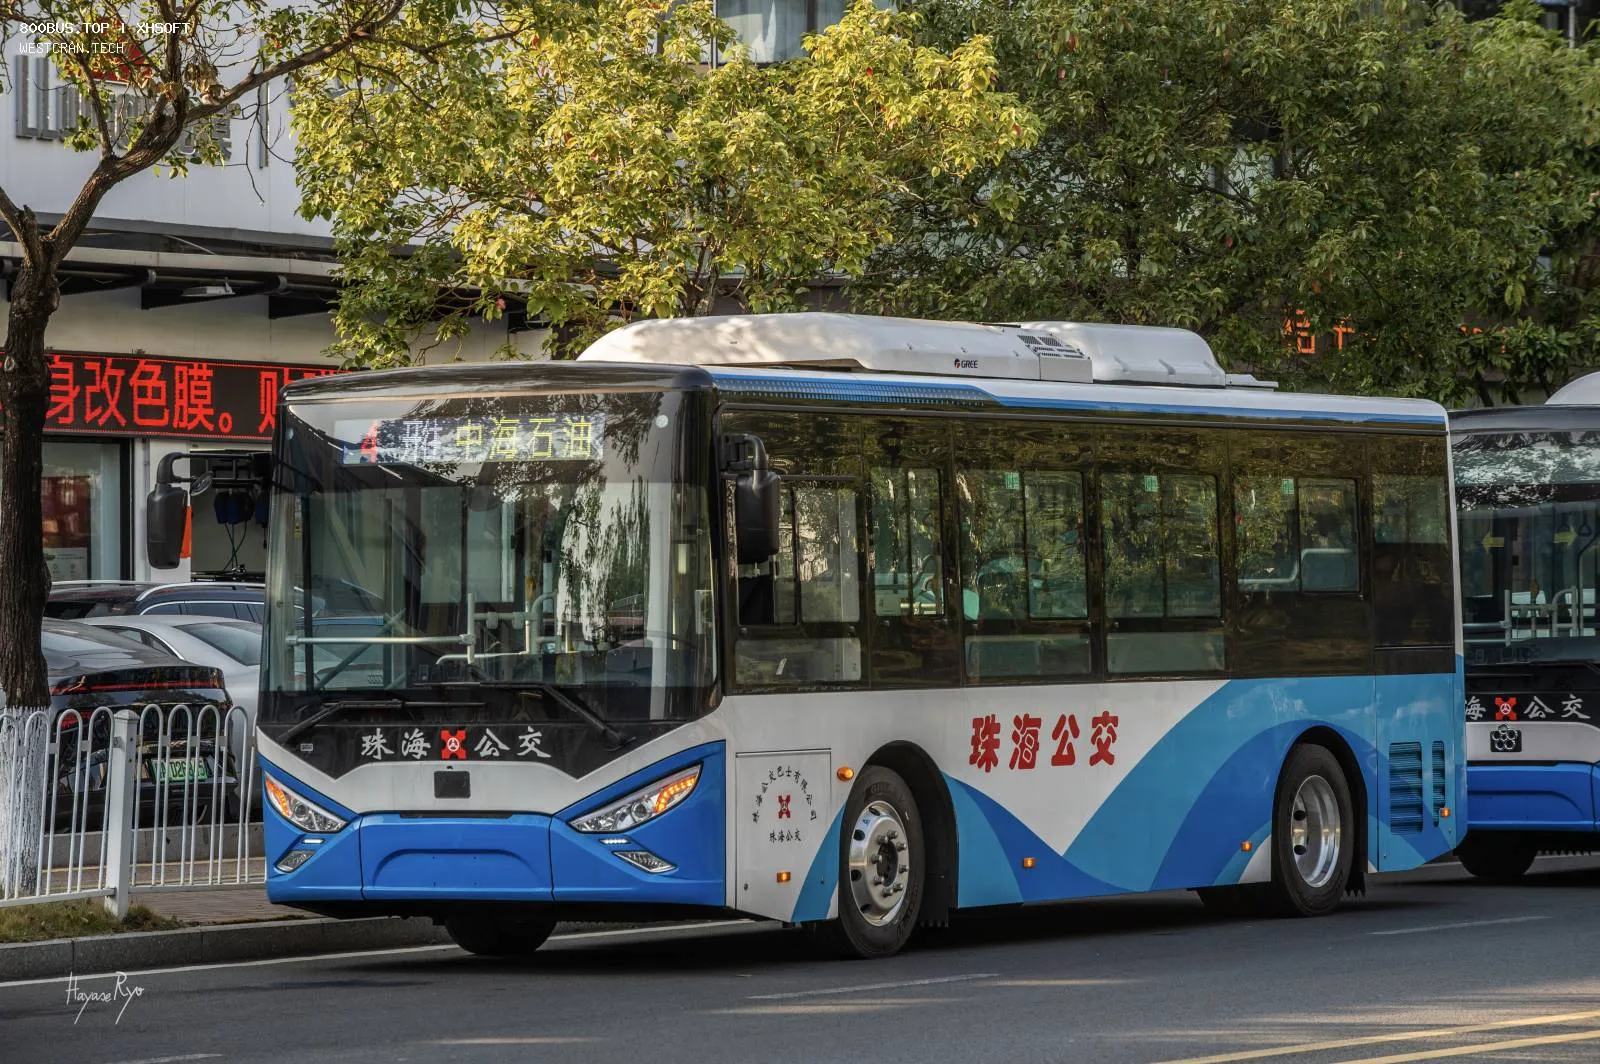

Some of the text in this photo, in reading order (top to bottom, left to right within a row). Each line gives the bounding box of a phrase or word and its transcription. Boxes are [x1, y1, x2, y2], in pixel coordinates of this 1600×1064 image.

[961, 359, 978, 369] GREE
[360, 419, 379, 464] 4
[456, 415, 592, 460] 中海石油
[1523, 693, 1591, 719] 公交
[361, 726, 552, 760] 珠海 公交
[969, 710, 1119, 773] 珠海公交
[769, 828, 802, 844] 珠海公交
